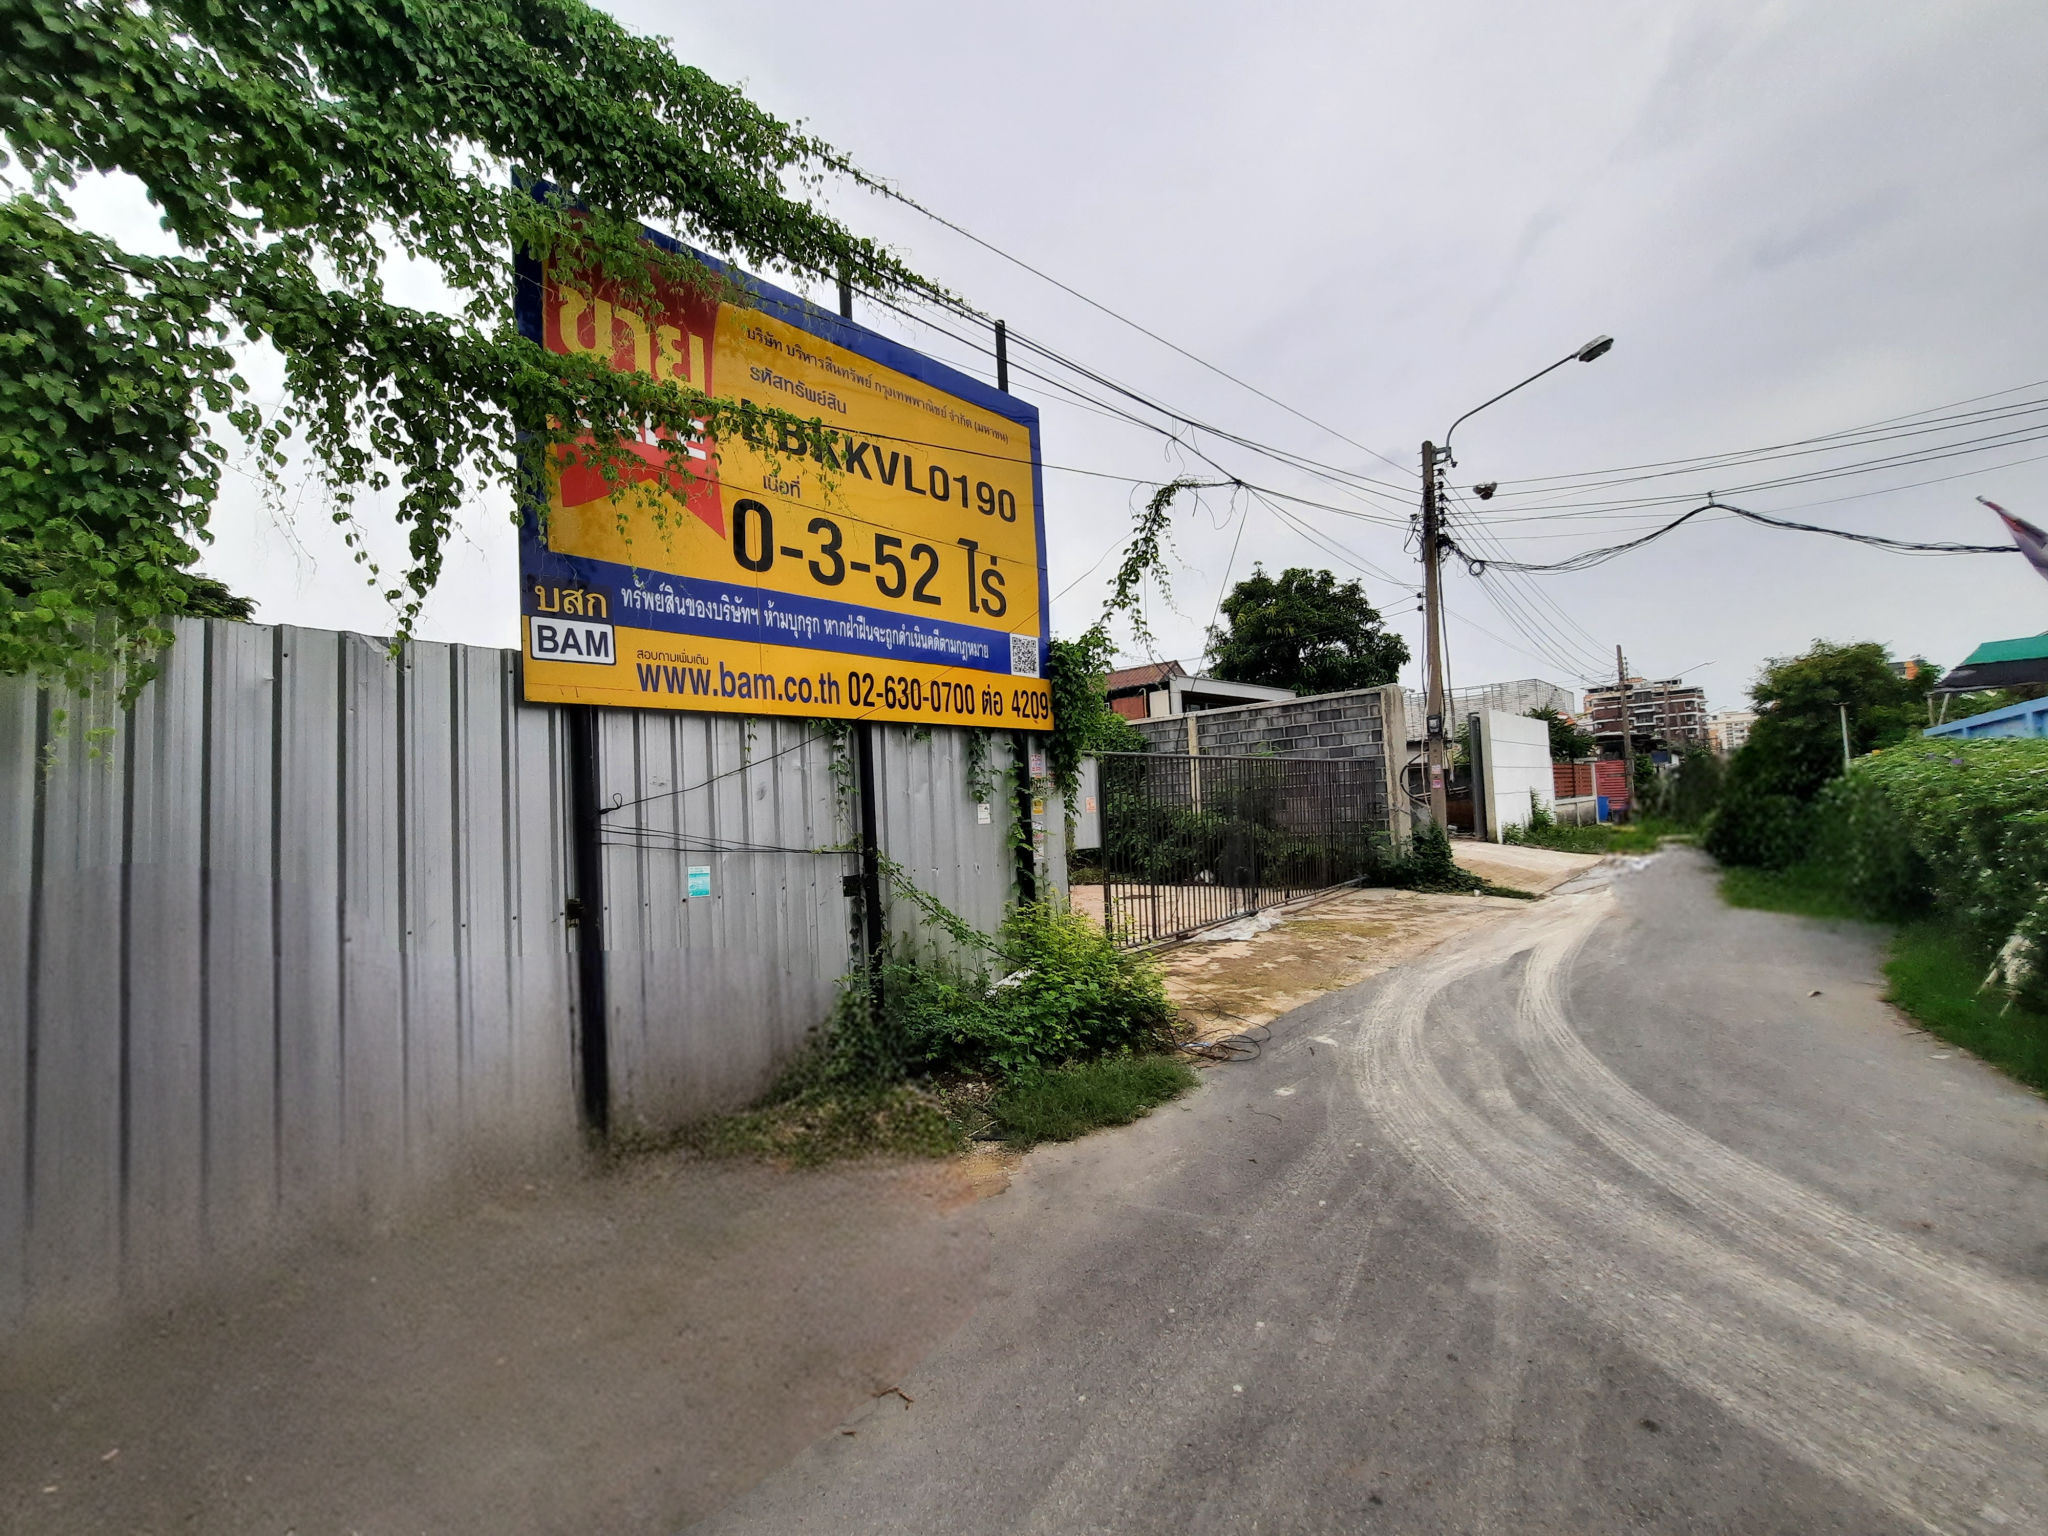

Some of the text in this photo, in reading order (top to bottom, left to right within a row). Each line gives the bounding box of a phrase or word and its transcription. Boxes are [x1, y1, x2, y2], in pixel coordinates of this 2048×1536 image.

[747, 327, 783, 352] บริษัท
[750, 366, 847, 414] รหัสทรัพย์สิน
[733, 498, 1007, 618] 0-3-52 ไร่
[534, 585, 607, 619] บสก
[621, 579, 760, 626] ทรัพย์สินของบริษัทฯ
[764, 600, 820, 640] ห้ามบุกรุก
[537, 624, 609, 658] BAM
[636, 661, 1049, 719] www.bam.co.th 02-630-0700 ต่อ 4209
